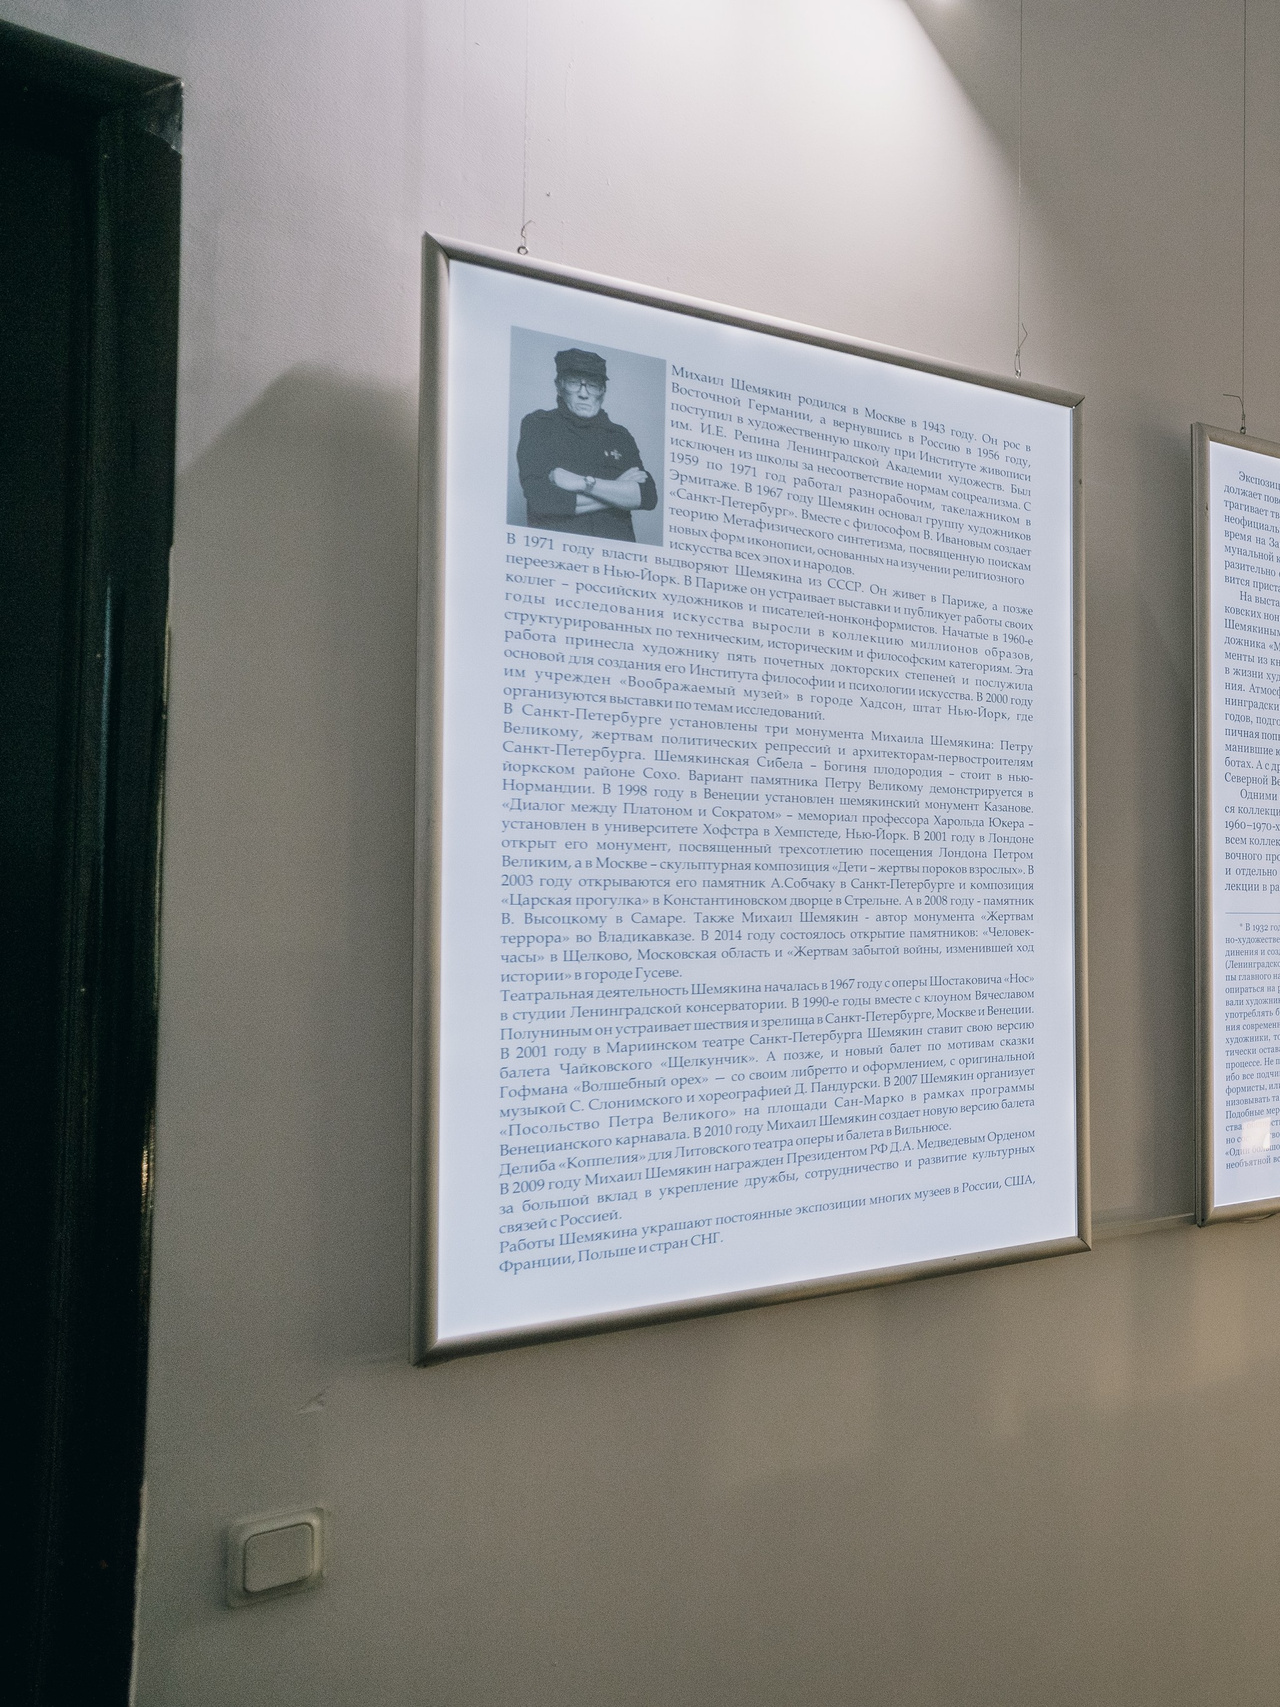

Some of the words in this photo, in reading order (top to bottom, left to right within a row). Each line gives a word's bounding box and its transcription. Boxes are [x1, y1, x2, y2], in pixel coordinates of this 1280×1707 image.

[672, 365, 724, 386] Михаил
[731, 377, 791, 401] Шемякин
[798, 396, 846, 413] родился
[853, 407, 859, 415] в
[865, 407, 906, 425] Москве
[923, 420, 945, 434] 1943
[951, 429, 977, 443] году.
[982, 434, 998, 445] Он
[1003, 440, 1020, 450] рос
[672, 382, 740, 407] Восточной
[748, 398, 813, 423] Германии,
[833, 419, 902, 440] вернувшись
[909, 435, 914, 443] в
[921, 435, 960, 452] Россию
[966, 447, 972, 455] в
[978, 447, 1000, 460] 1956
[1005, 455, 1031, 469] году,
[1223, 485, 1262, 500] должает
[1224, 530, 1252, 542] время
[1255, 536, 1266, 546] на
[507, 532, 516, 544] В
[525, 535, 553, 550] 1971
[563, 543, 594, 559] году
[602, 549, 647, 563] власти
[655, 556, 729, 574] выдворяют
[735, 564, 802, 584] Шемякина
[808, 578, 822, 587] из
[827, 578, 864, 593] СССР.
[870, 584, 887, 596] Он
[892, 590, 926, 601] живет
[942, 594, 987, 610] Париже,
[1003, 605, 1033, 616] позже
[1224, 575, 1250, 587] вится
[504, 702, 513, 714] В
[521, 704, 662, 728] Санкт-Петербурге
[670, 718, 757, 732] установлены
[765, 725, 788, 737] три
[796, 727, 864, 741] монумента
[871, 730, 924, 744] Михаила
[931, 735, 994, 749] Шемякина:
[1000, 740, 1033, 755] Петру
[1224, 772, 1268, 786] Северной
[1224, 883, 1259, 892] лекции
[501, 1047, 510, 1060] В
[516, 1045, 546, 1059] 2001
[555, 1046, 587, 1059] году
[593, 1046, 601, 1054] в
[607, 1040, 697, 1056] Мариинском
[702, 1038, 744, 1050] театре
[749, 1029, 862, 1045] Санкт-Петербурга
[868, 1027, 923, 1038] Шемякин
[927, 1026, 963, 1035] ставит
[966, 1024, 993, 1033] свою
[997, 1022, 1034, 1034] версию
[500, 1238, 555, 1254] Работы
[559, 1228, 637, 1246] Шемякина
[642, 1218, 712, 1239] украшают
[716, 1208, 792, 1225] постоянные
[796, 1198, 866, 1215] экспозиции
[870, 1193, 911, 1205] многих
[915, 1188, 951, 1202] музеев
[953, 1186, 959, 1194] в
[962, 1181, 1002, 1193] России,
[1004, 1175, 1035, 1187] США,
[499, 1255, 575, 1275] Франции,
[578, 1247, 636, 1262] Польше
[639, 1245, 647, 1254] и
[649, 1239, 688, 1254] стран
[690, 1232, 723, 1246] СНГ.
